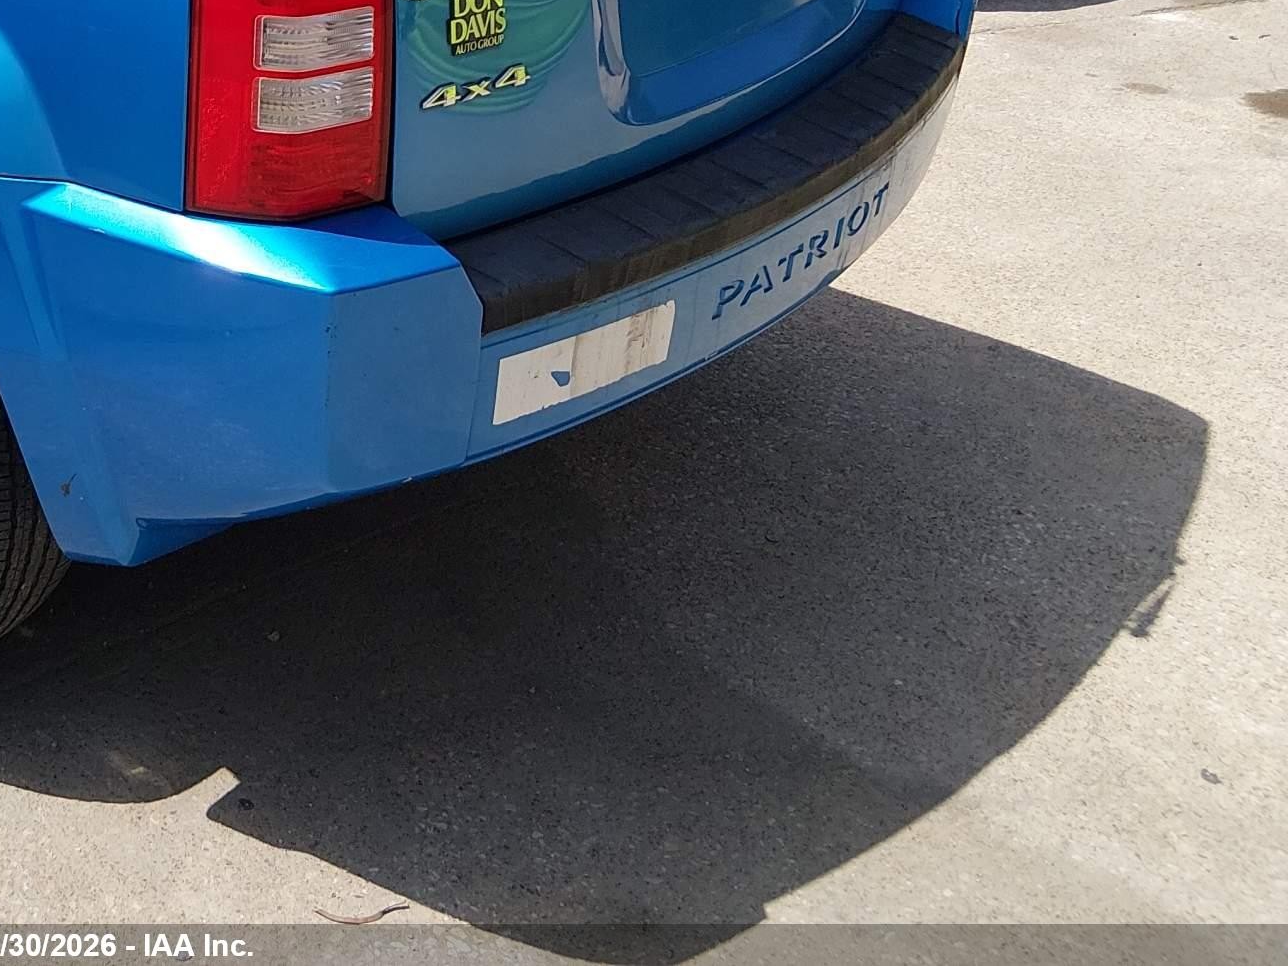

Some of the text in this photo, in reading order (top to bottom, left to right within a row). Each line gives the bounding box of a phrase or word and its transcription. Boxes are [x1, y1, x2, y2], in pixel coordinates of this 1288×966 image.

[451, 8, 506, 44] DAVIS
[455, 34, 505, 56] AUTO GROUP
[422, 65, 530, 109] 4x4
[711, 181, 889, 320] PATRIOT
